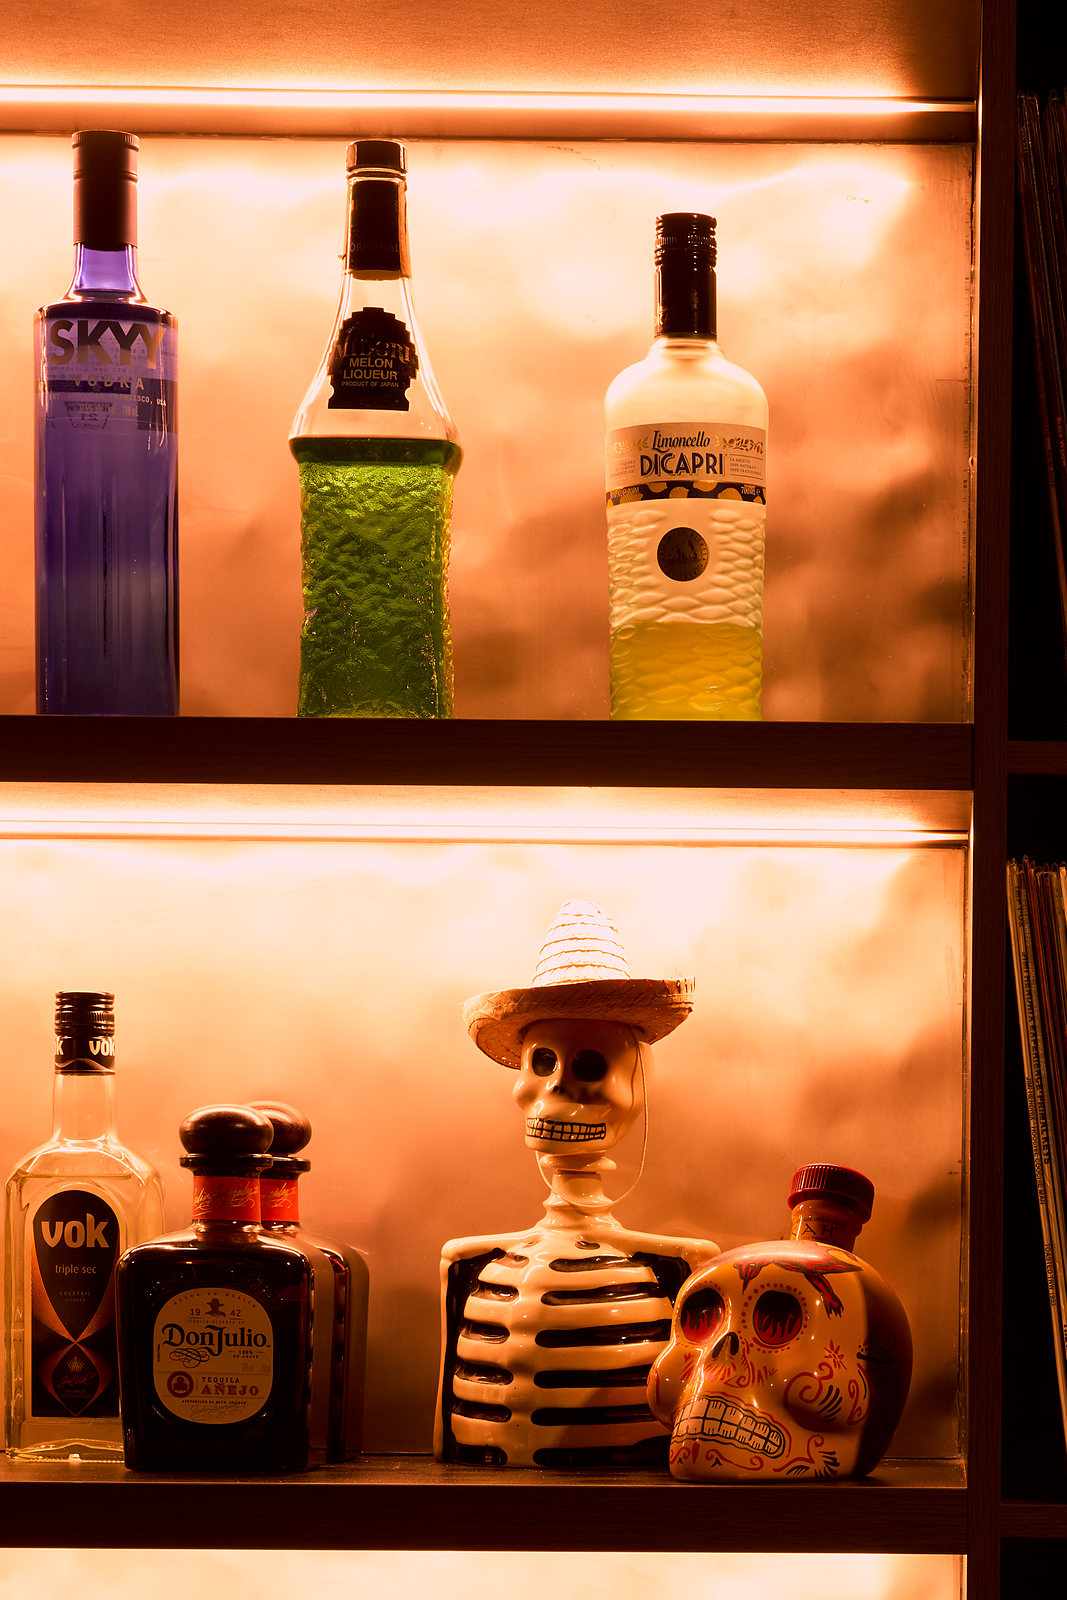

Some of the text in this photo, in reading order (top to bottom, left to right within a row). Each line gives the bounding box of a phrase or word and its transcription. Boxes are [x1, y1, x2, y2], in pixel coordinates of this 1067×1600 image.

[50, 319, 167, 370] SKYY
[349, 358, 394, 368] MELON
[343, 369, 398, 381] LIQUEUR
[74, 374, 145, 390] VODKA
[651, 431, 711, 453] Limoncello
[640, 453, 725, 477] DICAPRI
[55, 1263, 97, 1276] triple sec
[190, 1308, 200, 1316] 19
[201, 1383, 259, 1396] AÑEJO
